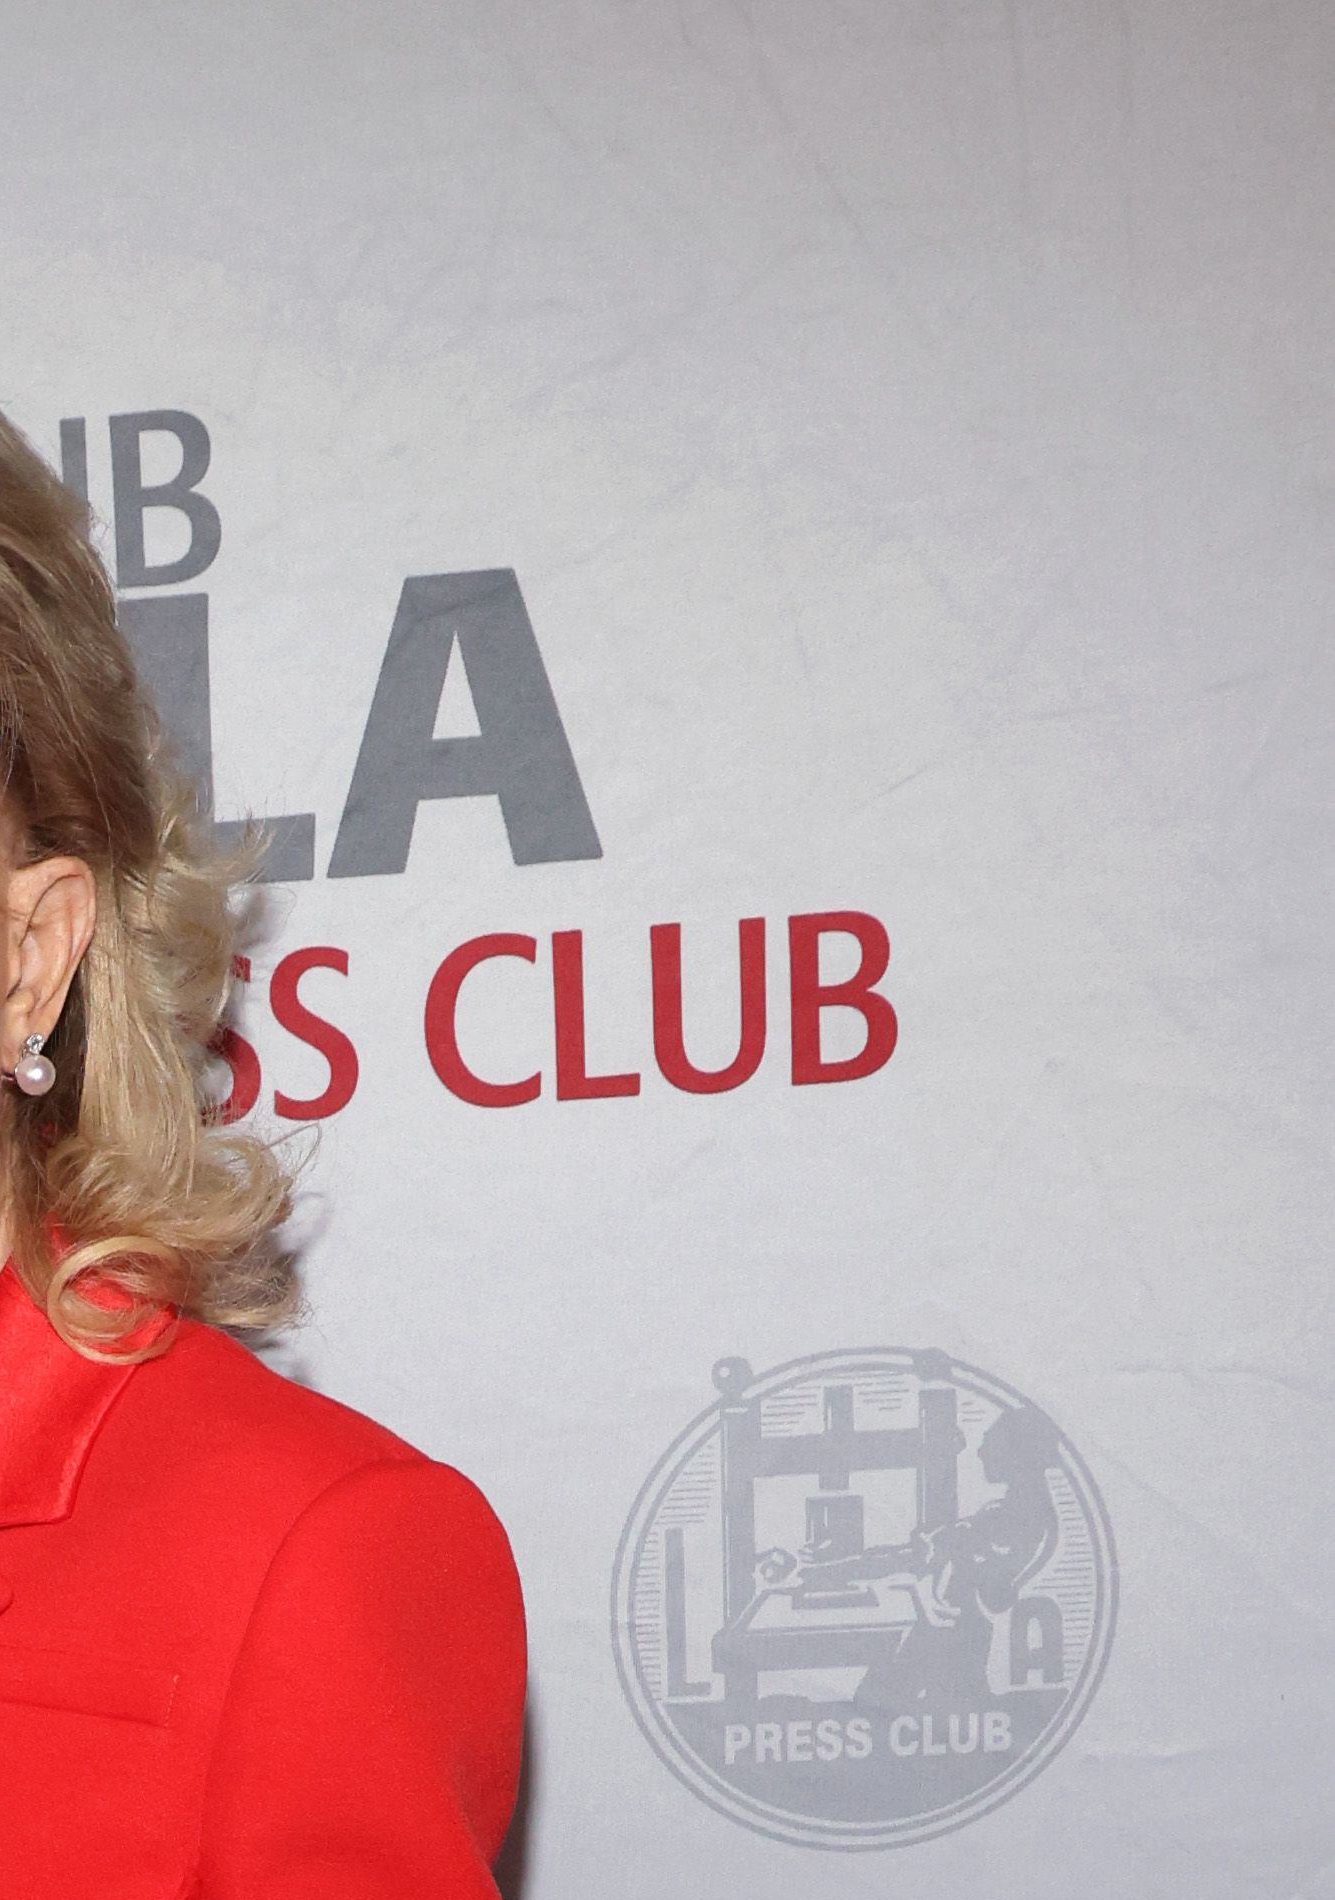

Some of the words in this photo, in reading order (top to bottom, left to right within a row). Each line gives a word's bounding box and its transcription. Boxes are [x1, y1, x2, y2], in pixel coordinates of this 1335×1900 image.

[116, 567, 604, 884] LA
[423, 910, 899, 1110] CLUB
[724, 1716, 873, 1766] PRESS
[888, 1711, 1013, 1759] CLUB
